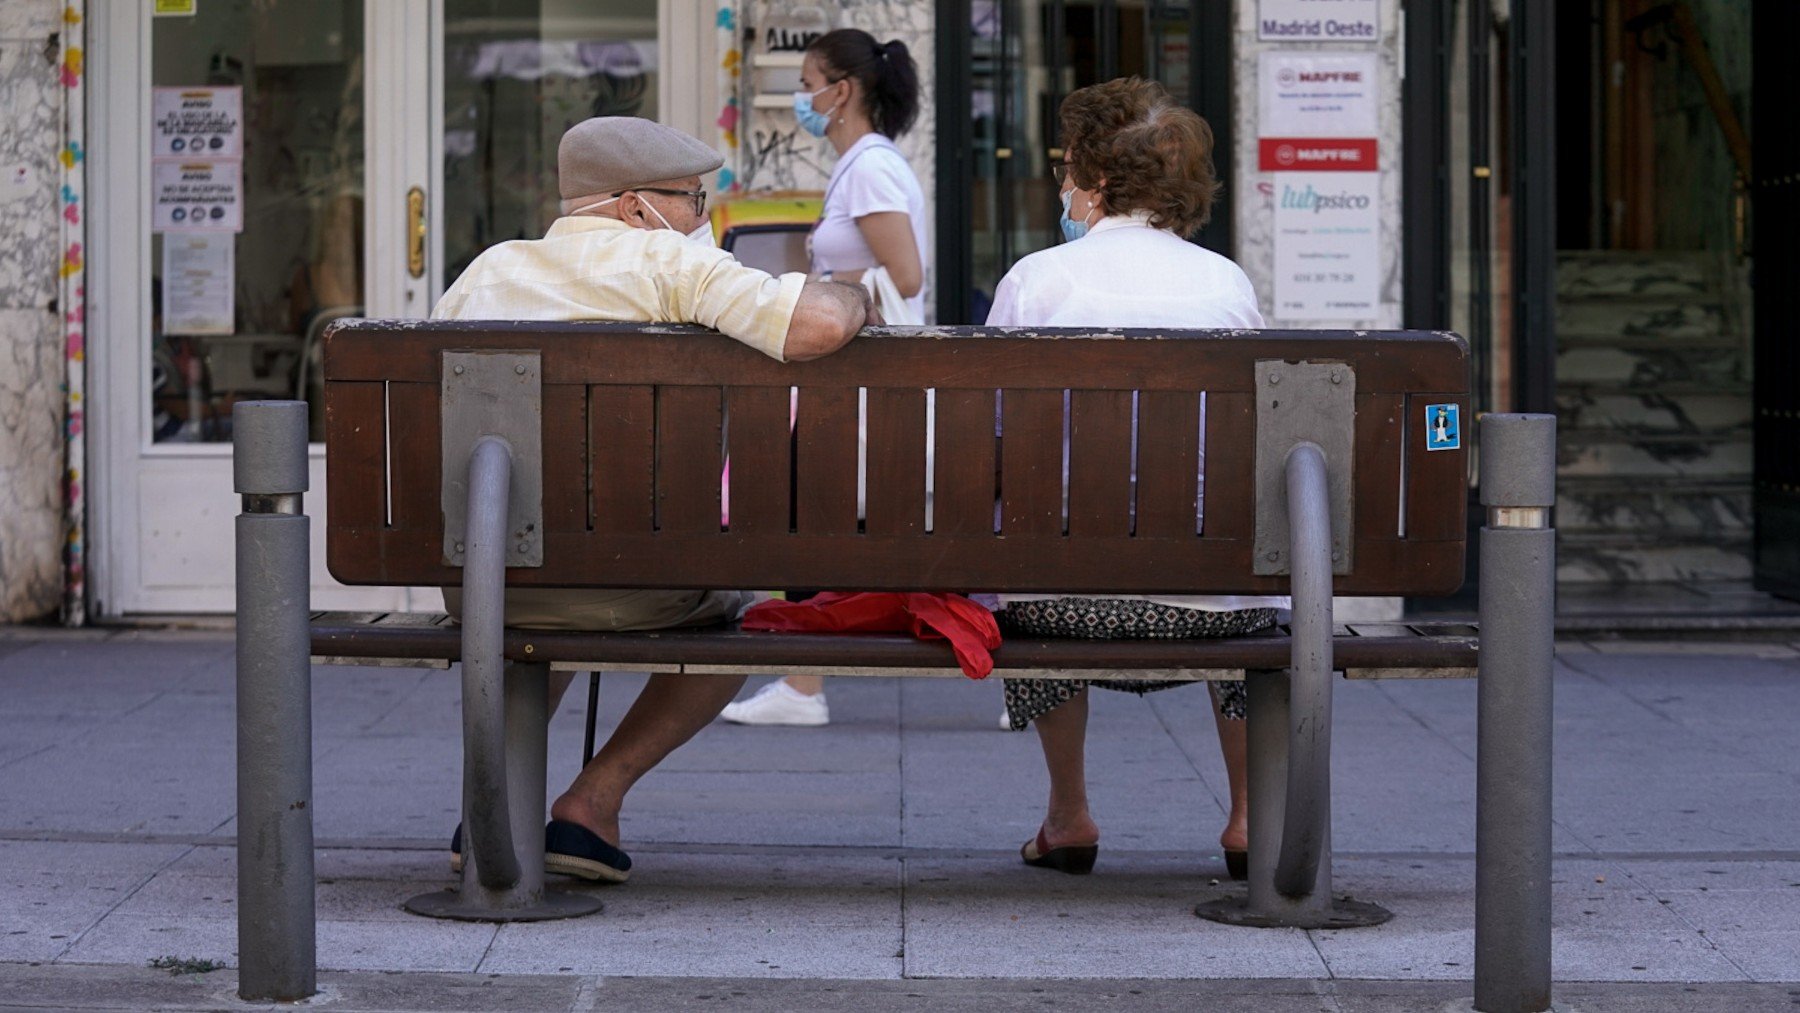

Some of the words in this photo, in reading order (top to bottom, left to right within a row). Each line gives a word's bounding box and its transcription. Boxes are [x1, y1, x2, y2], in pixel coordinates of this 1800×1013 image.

[1262, 20, 1320, 36] Madrid
[1325, 20, 1374, 36] Oeste
[1298, 71, 1362, 82] MAPFRE
[182, 100, 213, 109] AVISO
[1297, 149, 1361, 160] MAPFRE
[182, 172, 213, 180] AVISO
[1281, 184, 1370, 213] lubpsico
